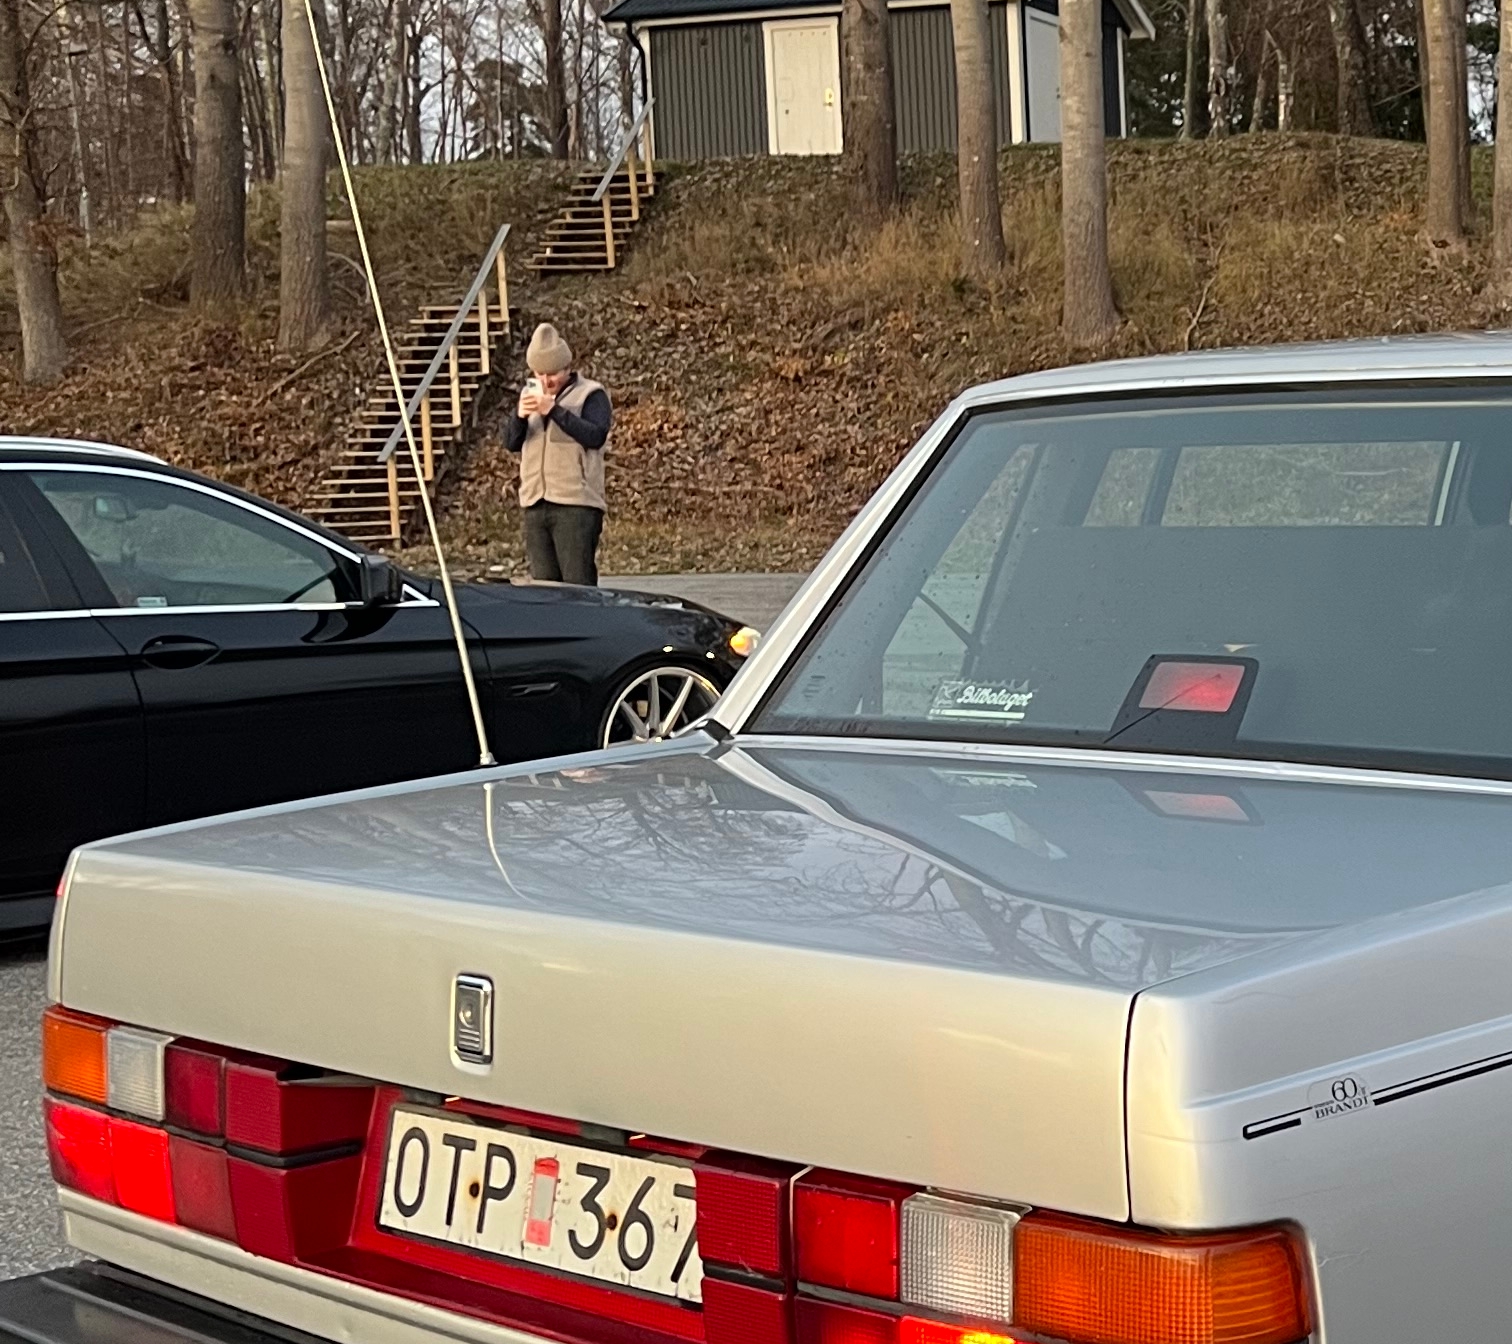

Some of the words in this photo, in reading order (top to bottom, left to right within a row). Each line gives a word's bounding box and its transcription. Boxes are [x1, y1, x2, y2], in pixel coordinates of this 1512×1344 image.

[1331, 1077, 1358, 1103] 60
[394, 1126, 517, 1234] OTP
[568, 1161, 698, 1283] 367
